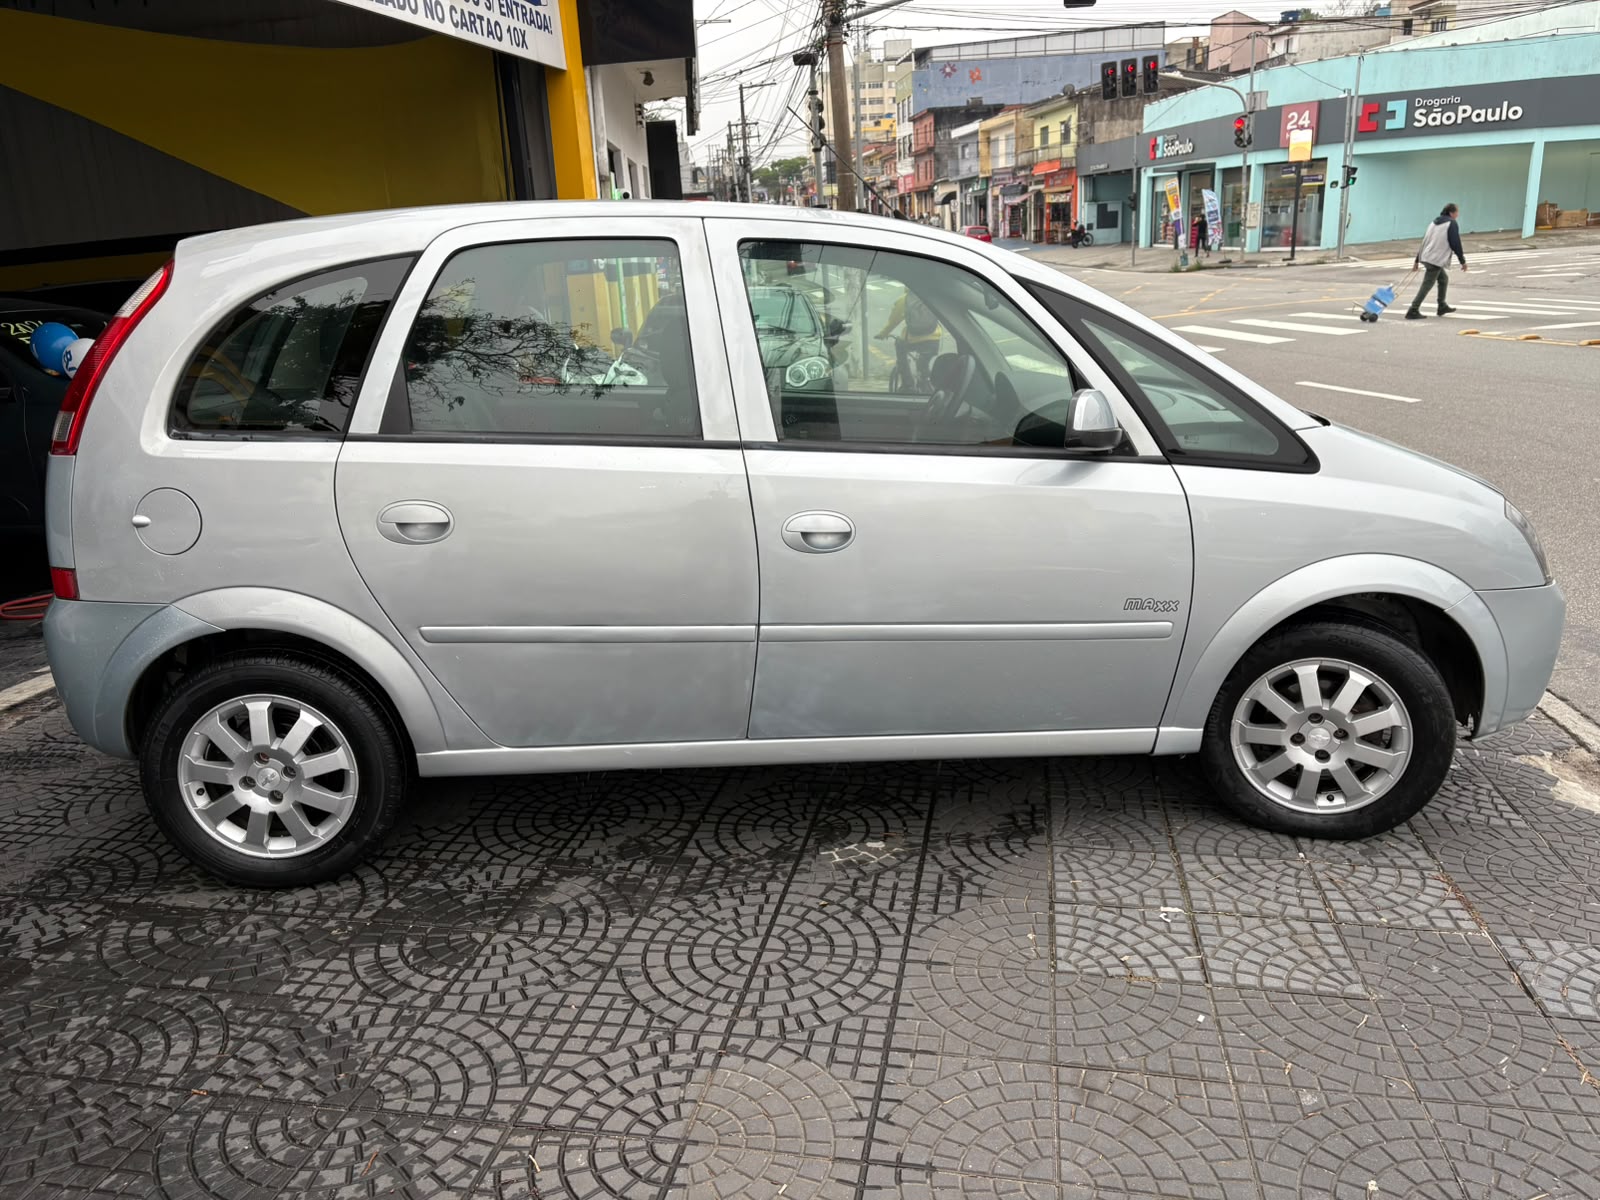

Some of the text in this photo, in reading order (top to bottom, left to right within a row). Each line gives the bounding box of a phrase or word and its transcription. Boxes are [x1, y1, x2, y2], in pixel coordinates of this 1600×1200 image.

[423, 0, 445, 24] NO
[449, 4, 503, 42] CARTAO
[506, 25, 528, 50] 10X
[499, 0, 553, 35] ENTRADA!
[1413, 100, 1523, 128] SãoPaulo
[1415, 96, 1461, 108] Drogaria
[1286, 110, 1311, 130] 24
